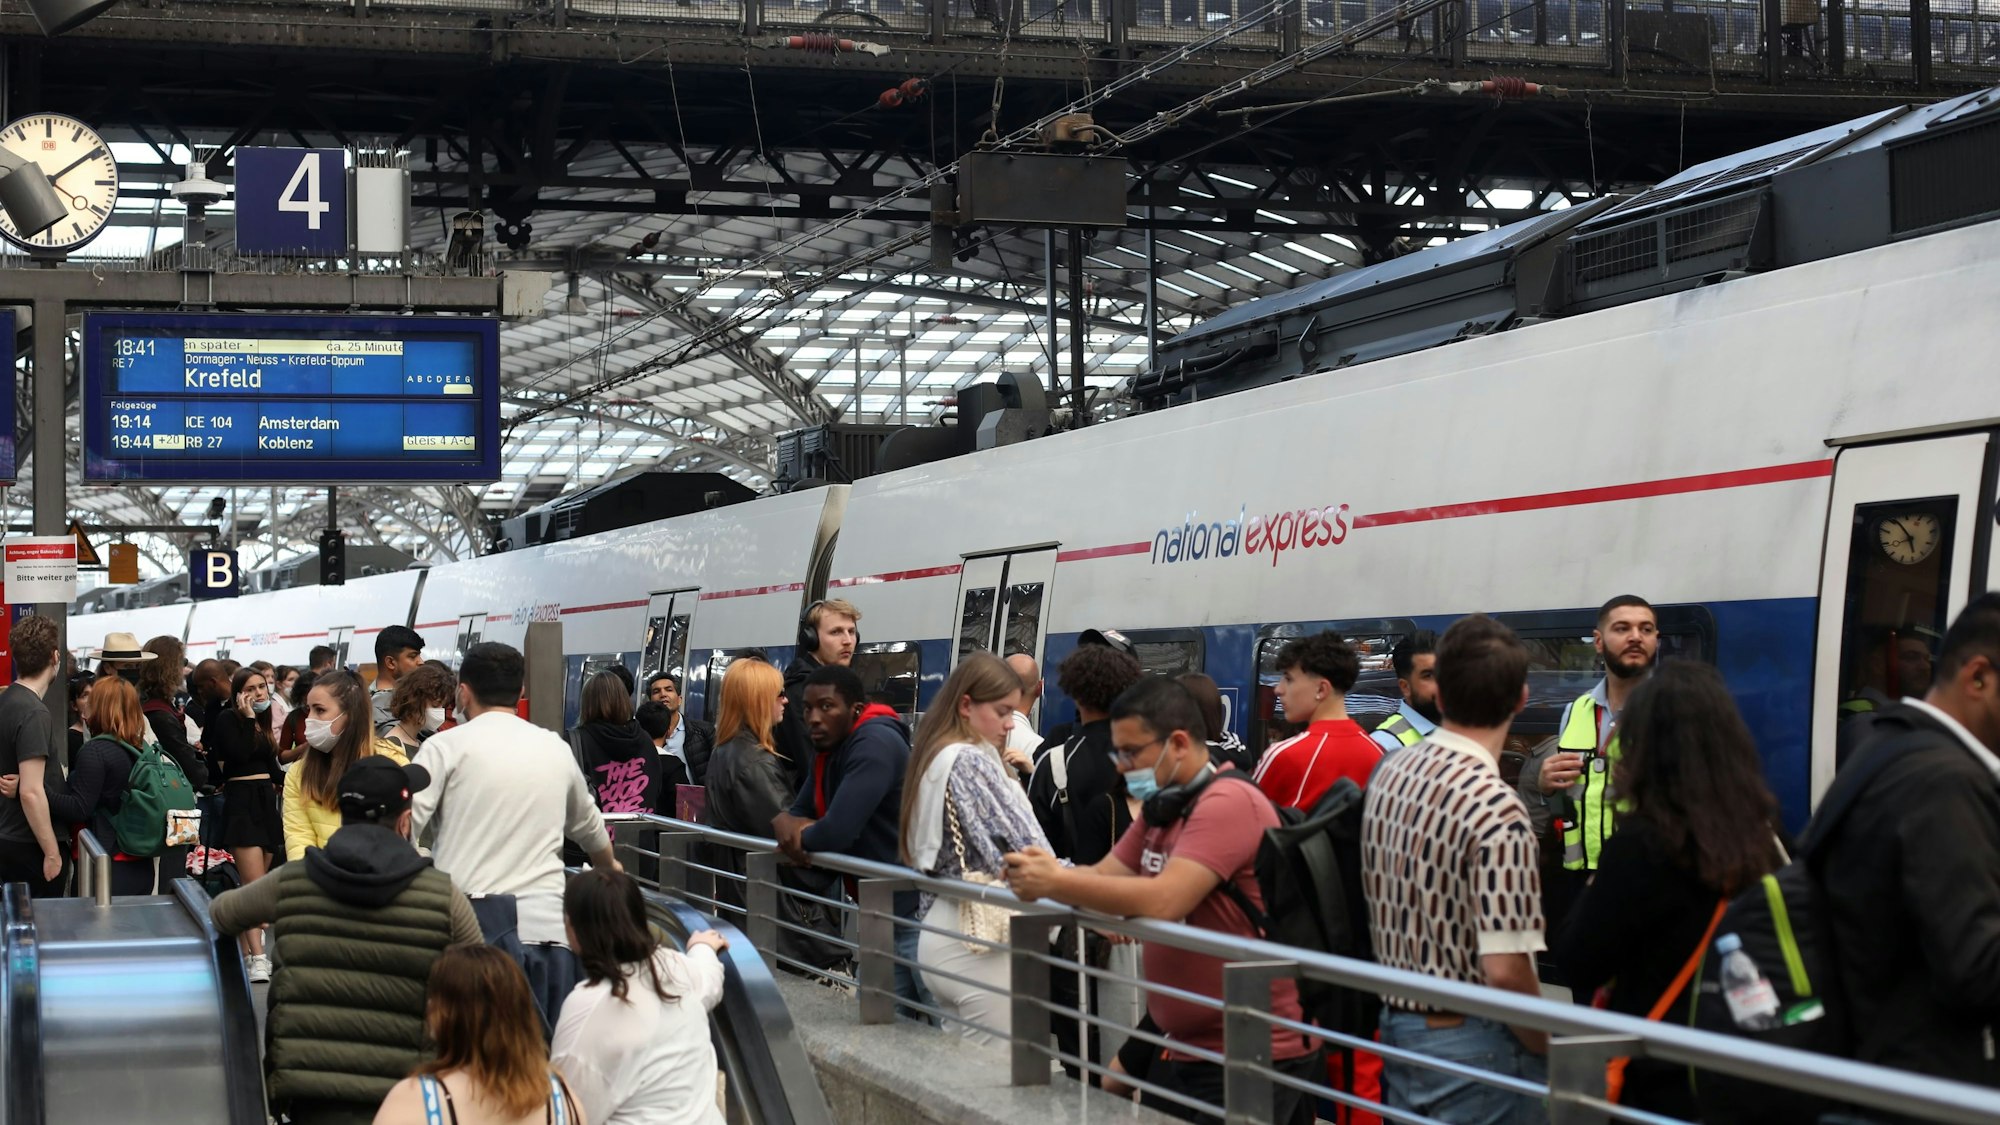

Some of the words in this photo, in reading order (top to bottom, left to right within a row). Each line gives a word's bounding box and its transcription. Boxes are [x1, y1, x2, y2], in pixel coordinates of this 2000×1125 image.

[278, 153, 330, 230] 4
[114, 339, 155, 356] 18:41
[326, 343, 344, 352] ca.
[348, 342, 361, 352] 25
[112, 358, 125, 368] RE
[128, 358, 135, 368] 7
[185, 354, 236, 367] Dormagen
[246, 354, 279, 365] Neuss
[288, 355, 365, 368] Krefeld-Oppum
[185, 368, 261, 388] Krefeld
[407, 375, 414, 383] A
[417, 375, 423, 383] B
[426, 375, 432, 383] C
[436, 375, 442, 383] D
[464, 375, 471, 383] G
[110, 401, 157, 410] Folgezüge
[112, 415, 151, 428] 19:14
[185, 416, 205, 428] ICE
[210, 416, 232, 428] 104
[259, 416, 340, 430] Amsterdam
[112, 435, 151, 448] 19:44
[159, 435, 180, 444] +20
[185, 436, 203, 448] RB
[207, 437, 223, 448] 27
[259, 436, 314, 449] Koblenz
[407, 435, 436, 446] Gleis
[440, 436, 446, 445] 4
[1152, 503, 1246, 565] national
[1245, 503, 1349, 567] express
[37, 573, 63, 581] weiter
[207, 552, 233, 588] B
